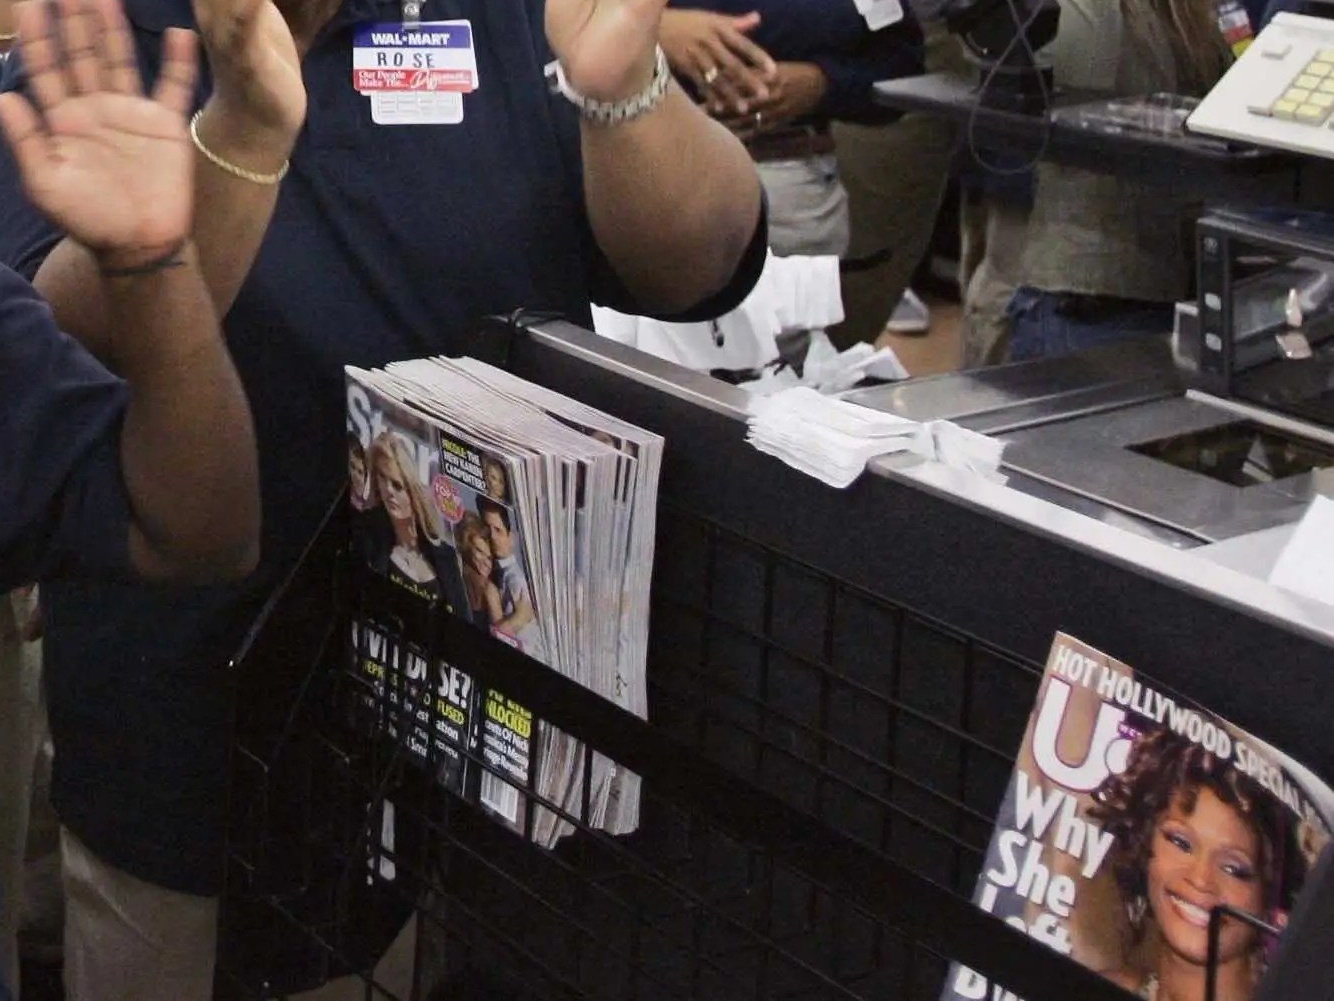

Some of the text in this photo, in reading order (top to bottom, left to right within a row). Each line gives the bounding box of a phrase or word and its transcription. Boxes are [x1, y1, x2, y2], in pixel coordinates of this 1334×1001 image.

[377, 51, 436, 68] ROSE
[1053, 645, 1098, 689] HOT
[1097, 666, 1232, 760] HOLLYWOOD
[986, 830, 1076, 918] She
[1015, 771, 1116, 879] Why
